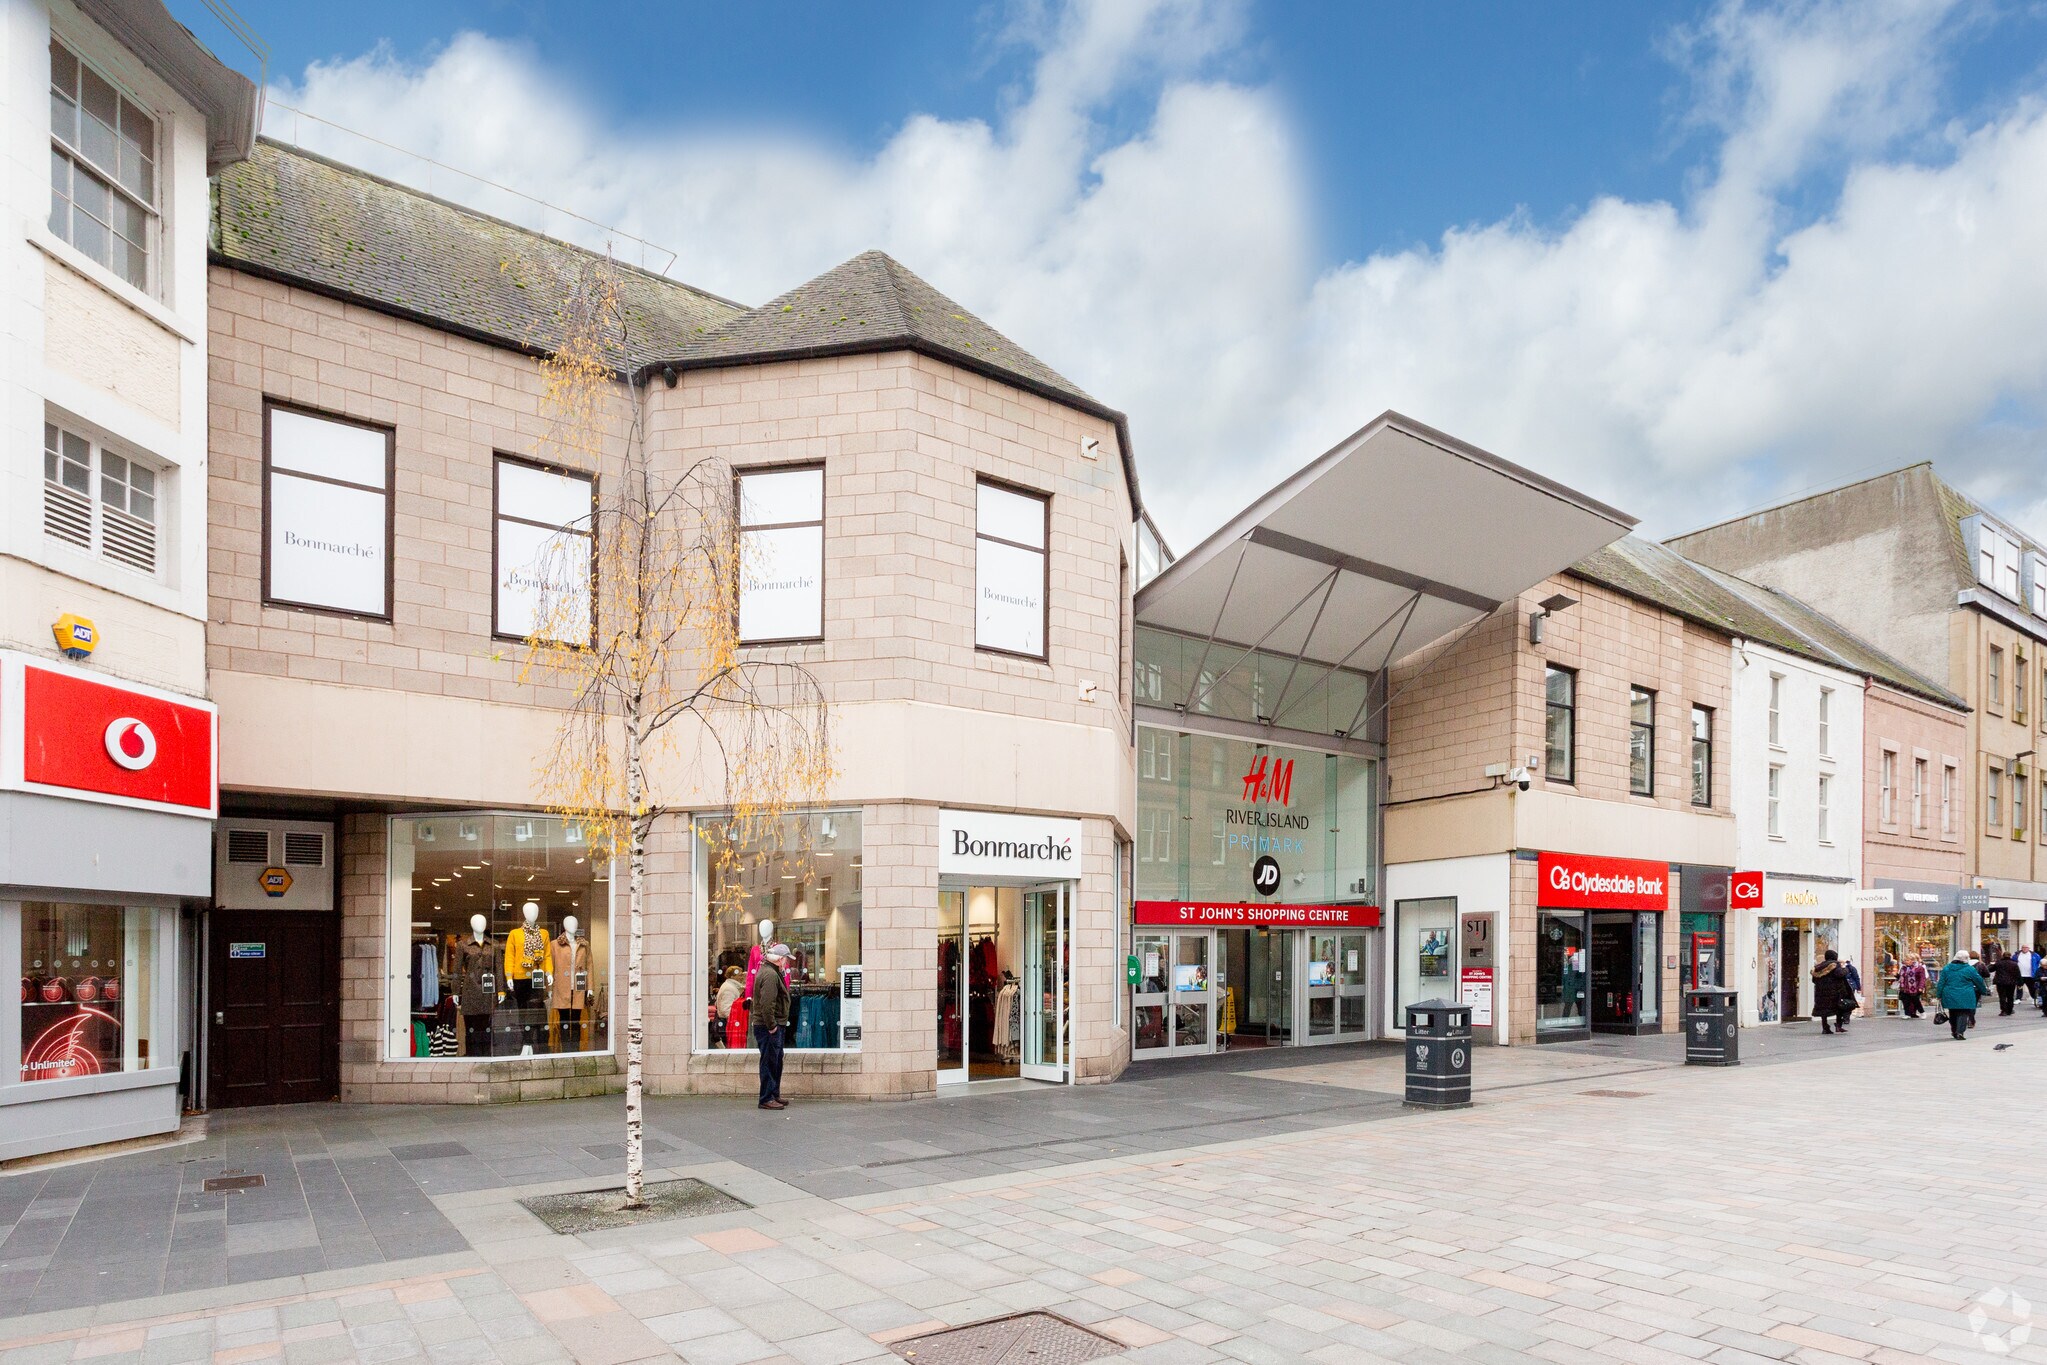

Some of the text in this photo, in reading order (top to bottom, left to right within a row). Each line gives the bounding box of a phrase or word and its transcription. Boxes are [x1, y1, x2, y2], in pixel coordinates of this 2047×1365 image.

[284, 530, 374, 560] Bonmarché
[509, 572, 582, 597] Bonmarché
[749, 576, 813, 592] Bonmarché
[984, 587, 1037, 609] Bonmarché
[74, 628, 91, 640] ADT
[1242, 755, 1294, 807] H&M
[1226, 809, 1309, 830] RIVER ISLAND
[953, 829, 1072, 861] Bonmarché
[1229, 834, 1305, 854] PRIMARK
[267, 876, 284, 884] ADT
[1257, 865, 1278, 885] JD
[1572, 871, 1635, 895] Clydesdale
[1637, 877, 1663, 895] Bank
[1180, 907, 1349, 921] ST JOHN'S SHOPPING CENTRE
[1984, 912, 2004, 925] GAP
[30, 1058, 76, 1070] Unlimited
